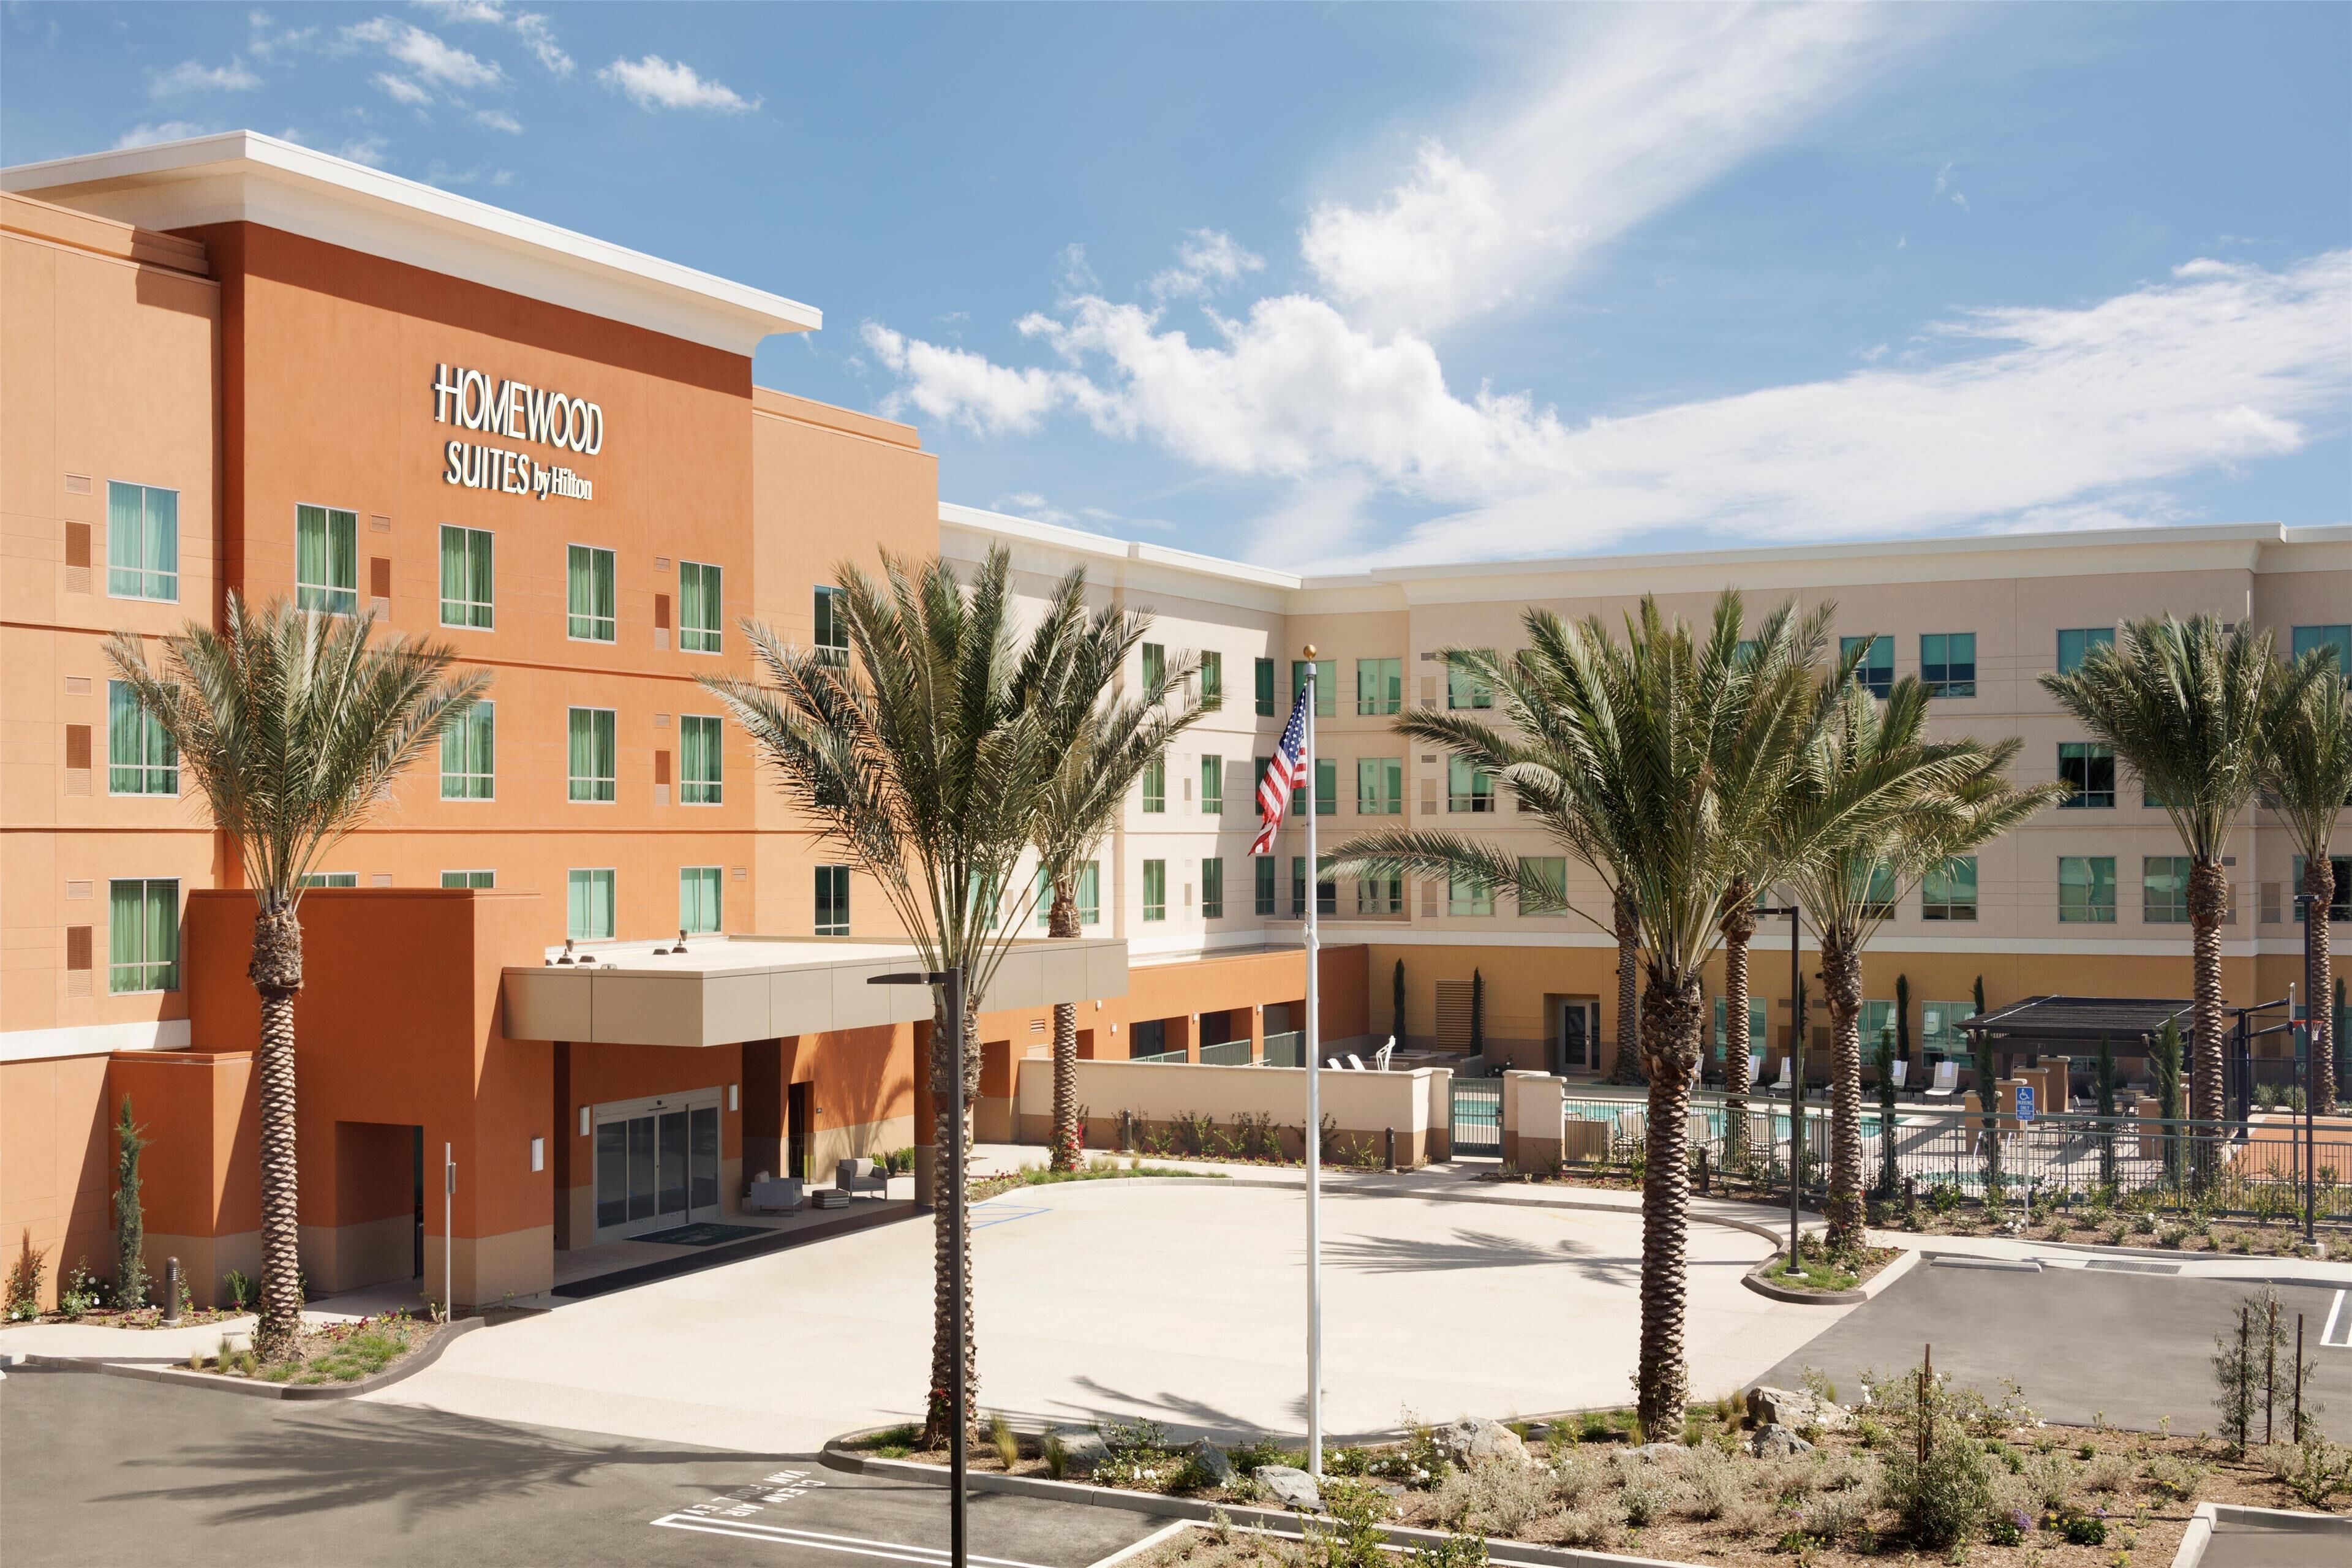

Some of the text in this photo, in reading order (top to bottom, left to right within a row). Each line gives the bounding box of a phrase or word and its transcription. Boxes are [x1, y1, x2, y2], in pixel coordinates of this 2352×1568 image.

[431, 363, 603, 455] HOMEWOOD
[443, 441, 592, 500] SUITES by Hilton
[683, 1470, 811, 1515] VAN POOL EV
[719, 1480, 826, 1517] CLEAN AIR
